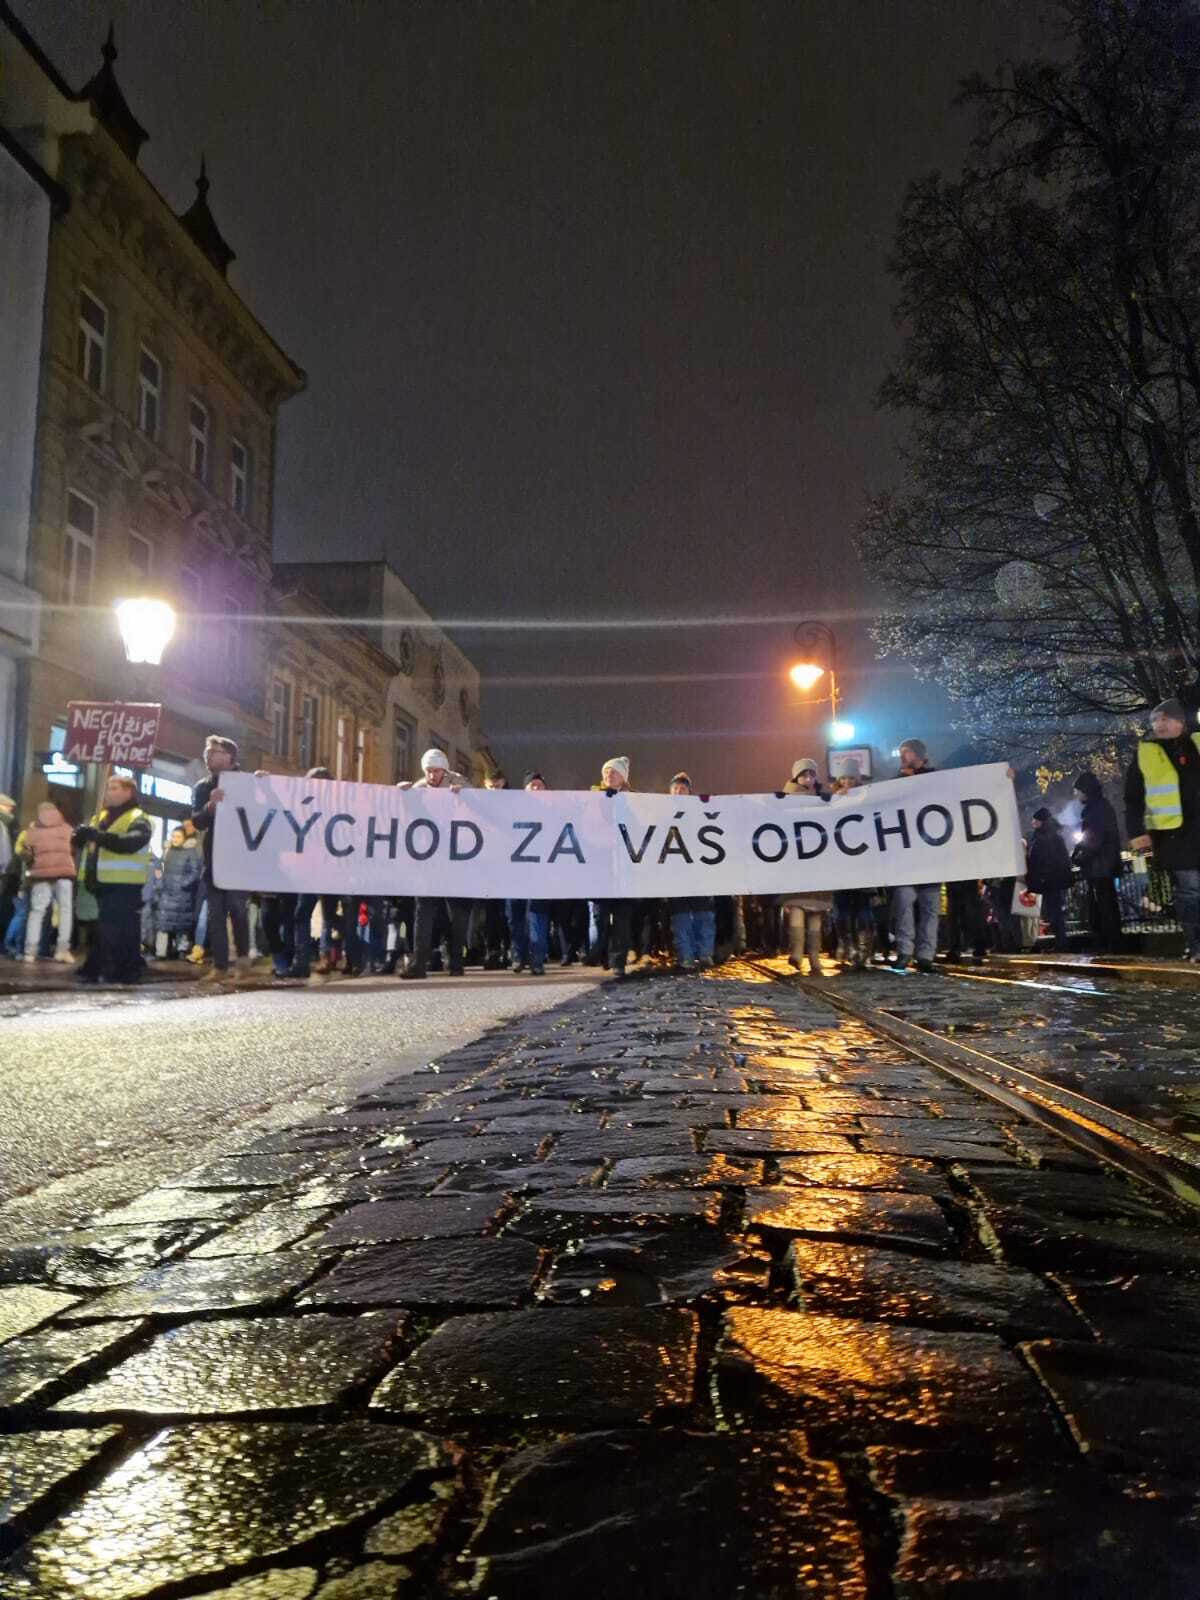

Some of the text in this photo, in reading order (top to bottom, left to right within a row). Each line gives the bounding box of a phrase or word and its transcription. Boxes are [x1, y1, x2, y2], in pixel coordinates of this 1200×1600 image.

[73, 709, 125, 729] NECH
[97, 729, 133, 746] FICO
[67, 743, 104, 761] ALE
[236, 796, 999, 865] VÝCHOD ZA VÁŠ ODCHOD
